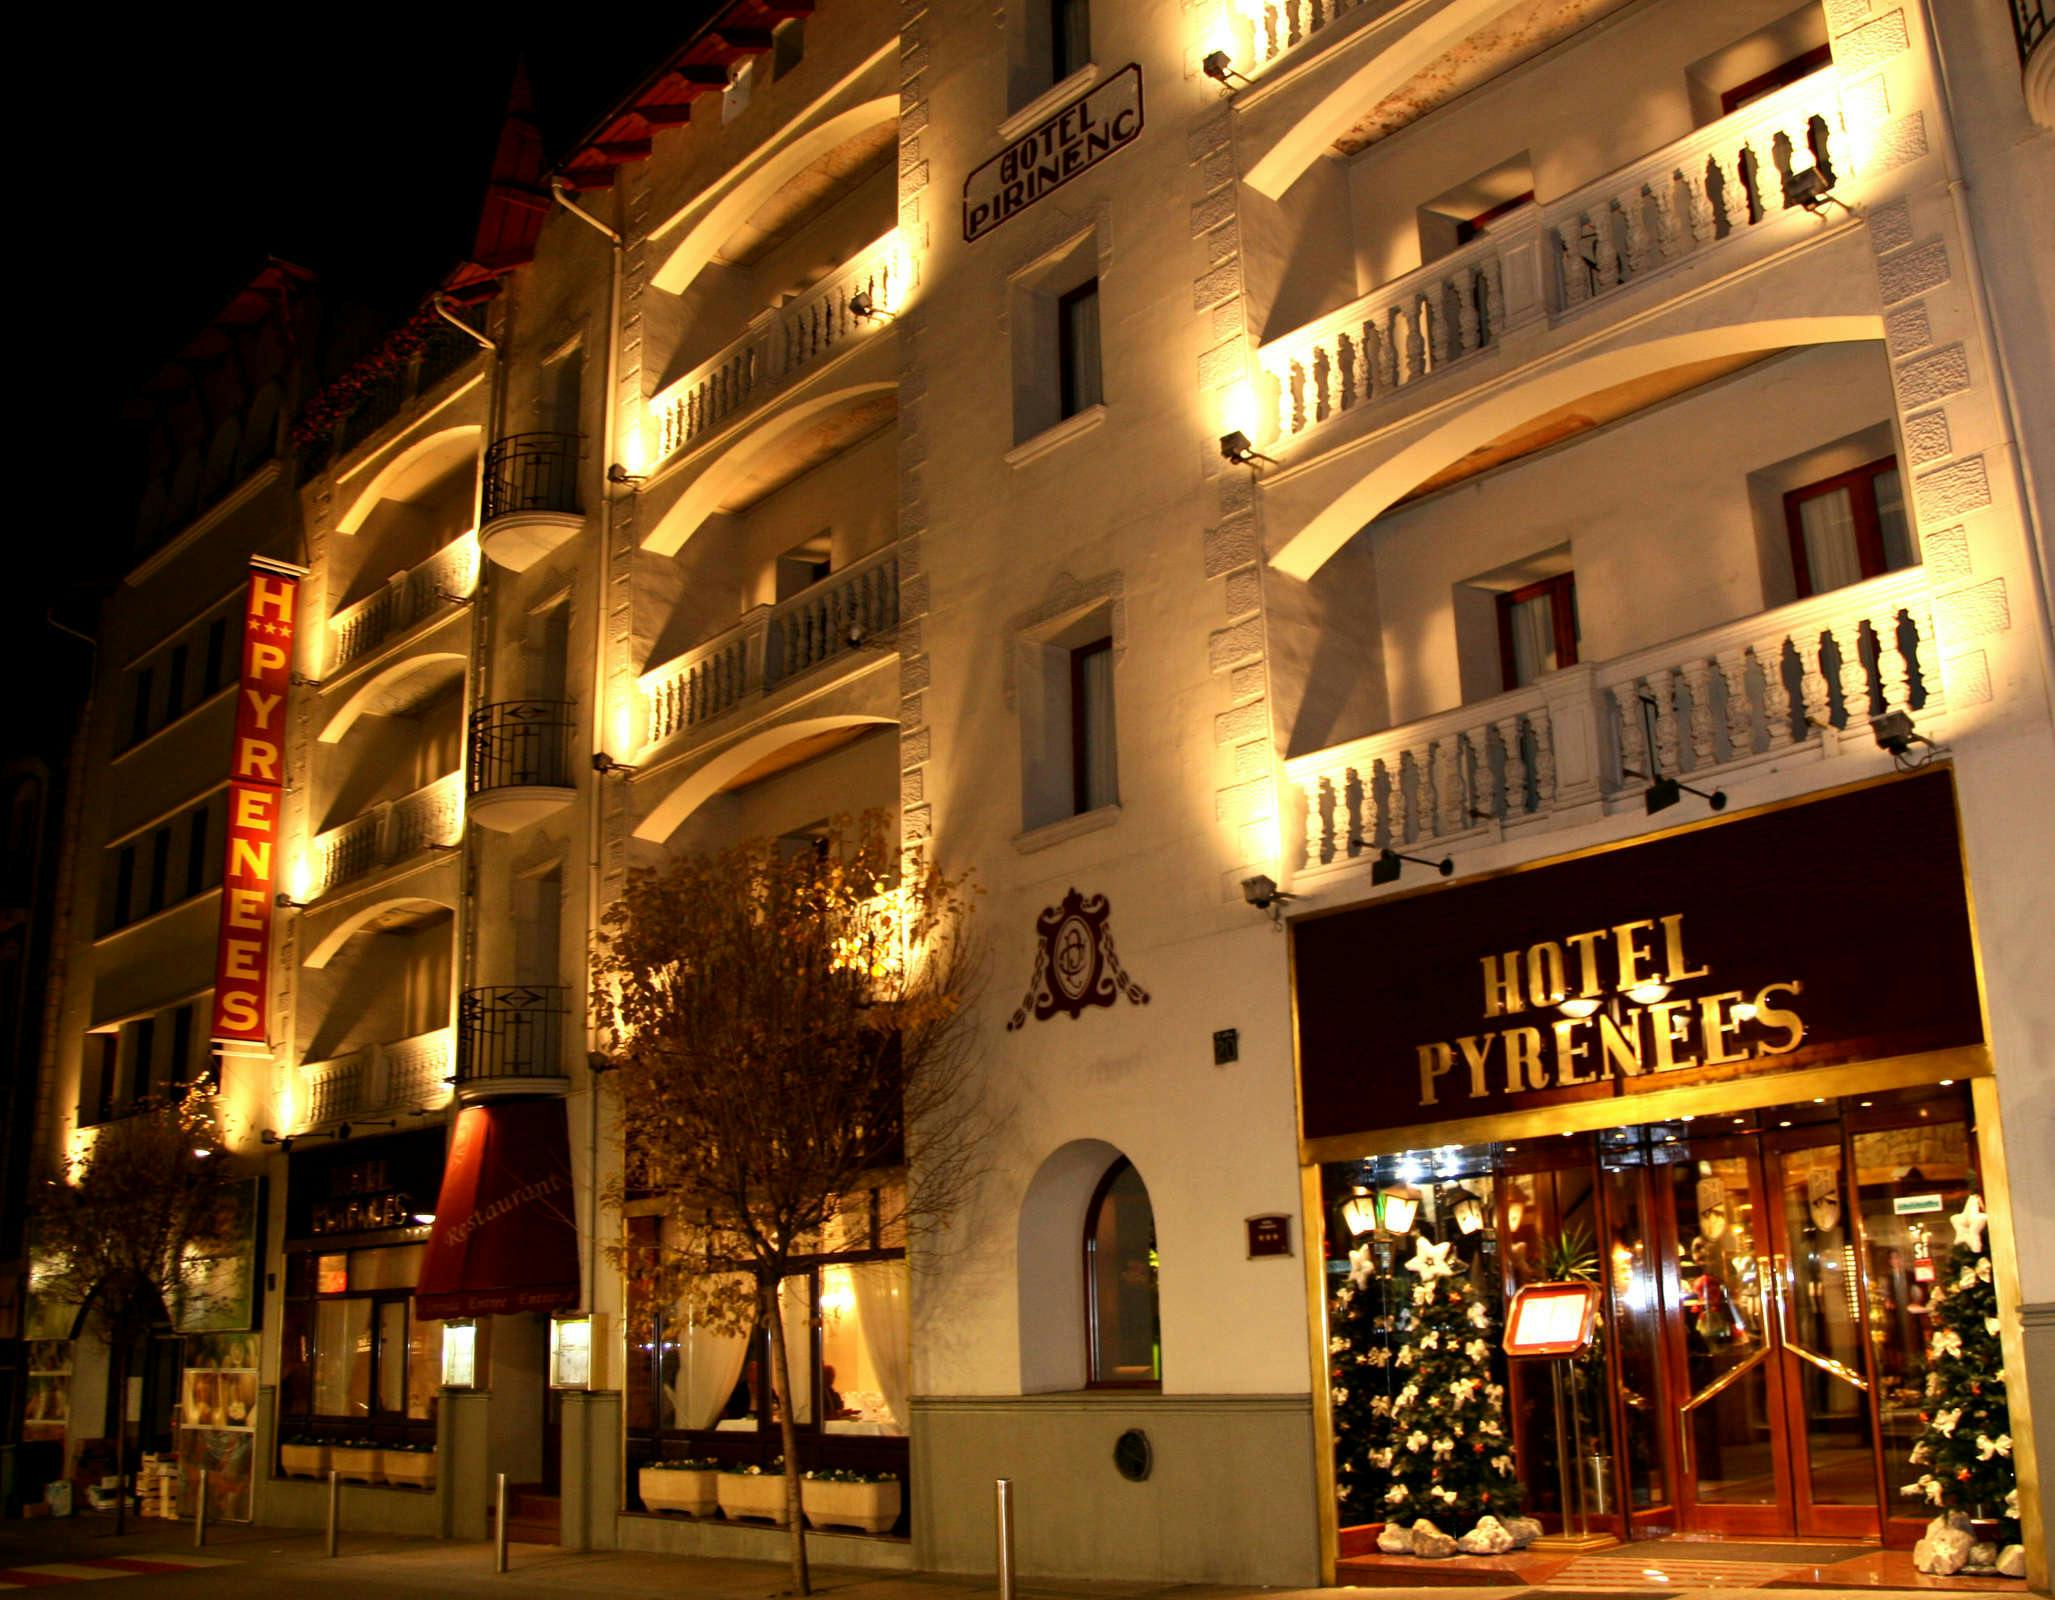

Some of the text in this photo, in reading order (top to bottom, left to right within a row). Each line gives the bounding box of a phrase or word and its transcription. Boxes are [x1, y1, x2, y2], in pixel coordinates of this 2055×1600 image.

[968, 109, 1136, 236] PIRINENC
[1000, 101, 1096, 185] HOTEL
[249, 575, 295, 624] H
[218, 641, 287, 1032] PYRENEES
[1480, 913, 1710, 1019] HOTEL
[1416, 980, 1805, 1106] PYRENEES
